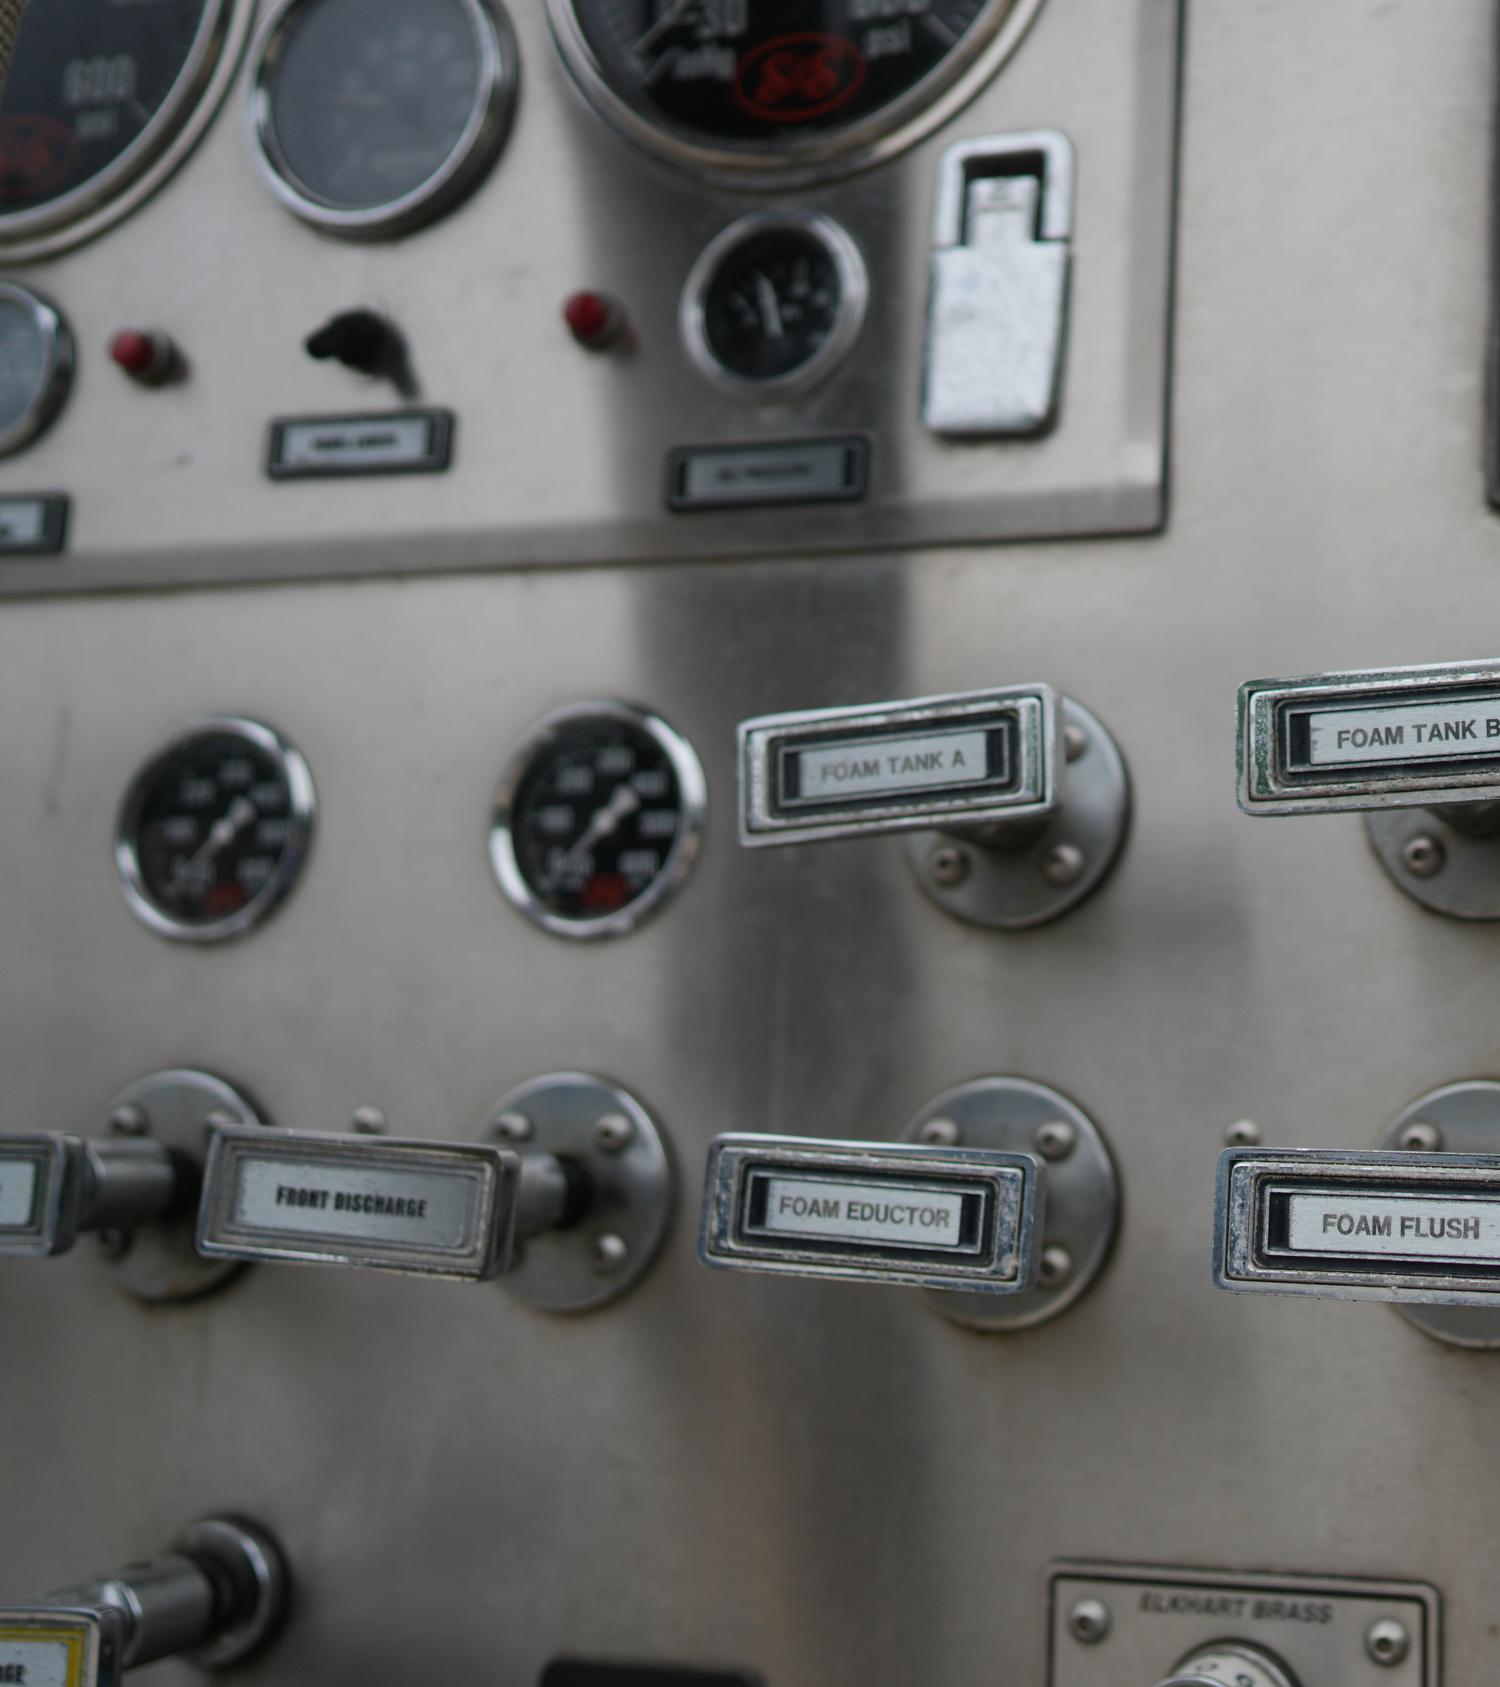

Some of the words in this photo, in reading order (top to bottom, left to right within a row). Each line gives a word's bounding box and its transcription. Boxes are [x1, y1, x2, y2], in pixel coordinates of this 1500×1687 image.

[1337, 726, 1404, 749] FOAM
[1412, 720, 1477, 743] TANK
[820, 759, 881, 782] FOAM
[887, 751, 943, 774] TANK
[951, 749, 966, 767] A
[276, 1185, 329, 1210] FRONT
[334, 1191, 427, 1218] DISCHARGE
[779, 1196, 840, 1219] FOAM
[846, 1201, 950, 1228] EDUCTOR
[1322, 1213, 1392, 1237] FOAM
[1399, 1216, 1480, 1240] FLUSH
[1139, 1592, 1246, 1619] ELKHART
[1253, 1599, 1334, 1625] BRASS
